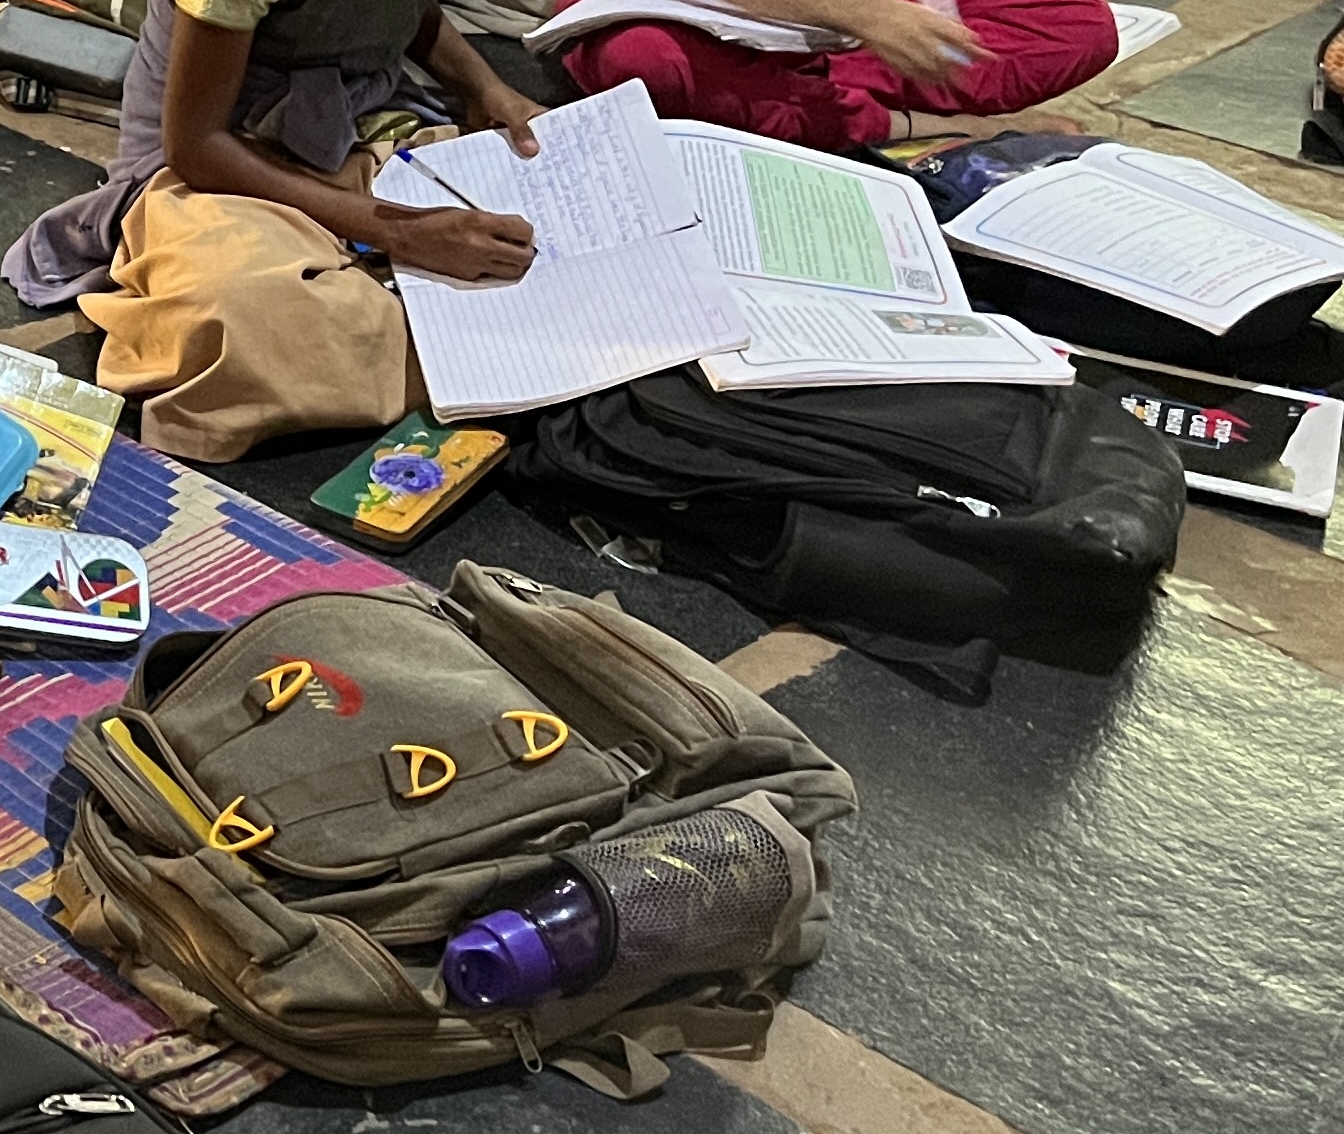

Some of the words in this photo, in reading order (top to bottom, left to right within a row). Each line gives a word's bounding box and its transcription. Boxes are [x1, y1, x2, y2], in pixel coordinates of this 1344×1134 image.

[1165, 408, 1184, 435] WHAT
[1188, 414, 1208, 438] CARE
[1213, 418, 1232, 443] STOP
[304, 673, 335, 709] NIK
